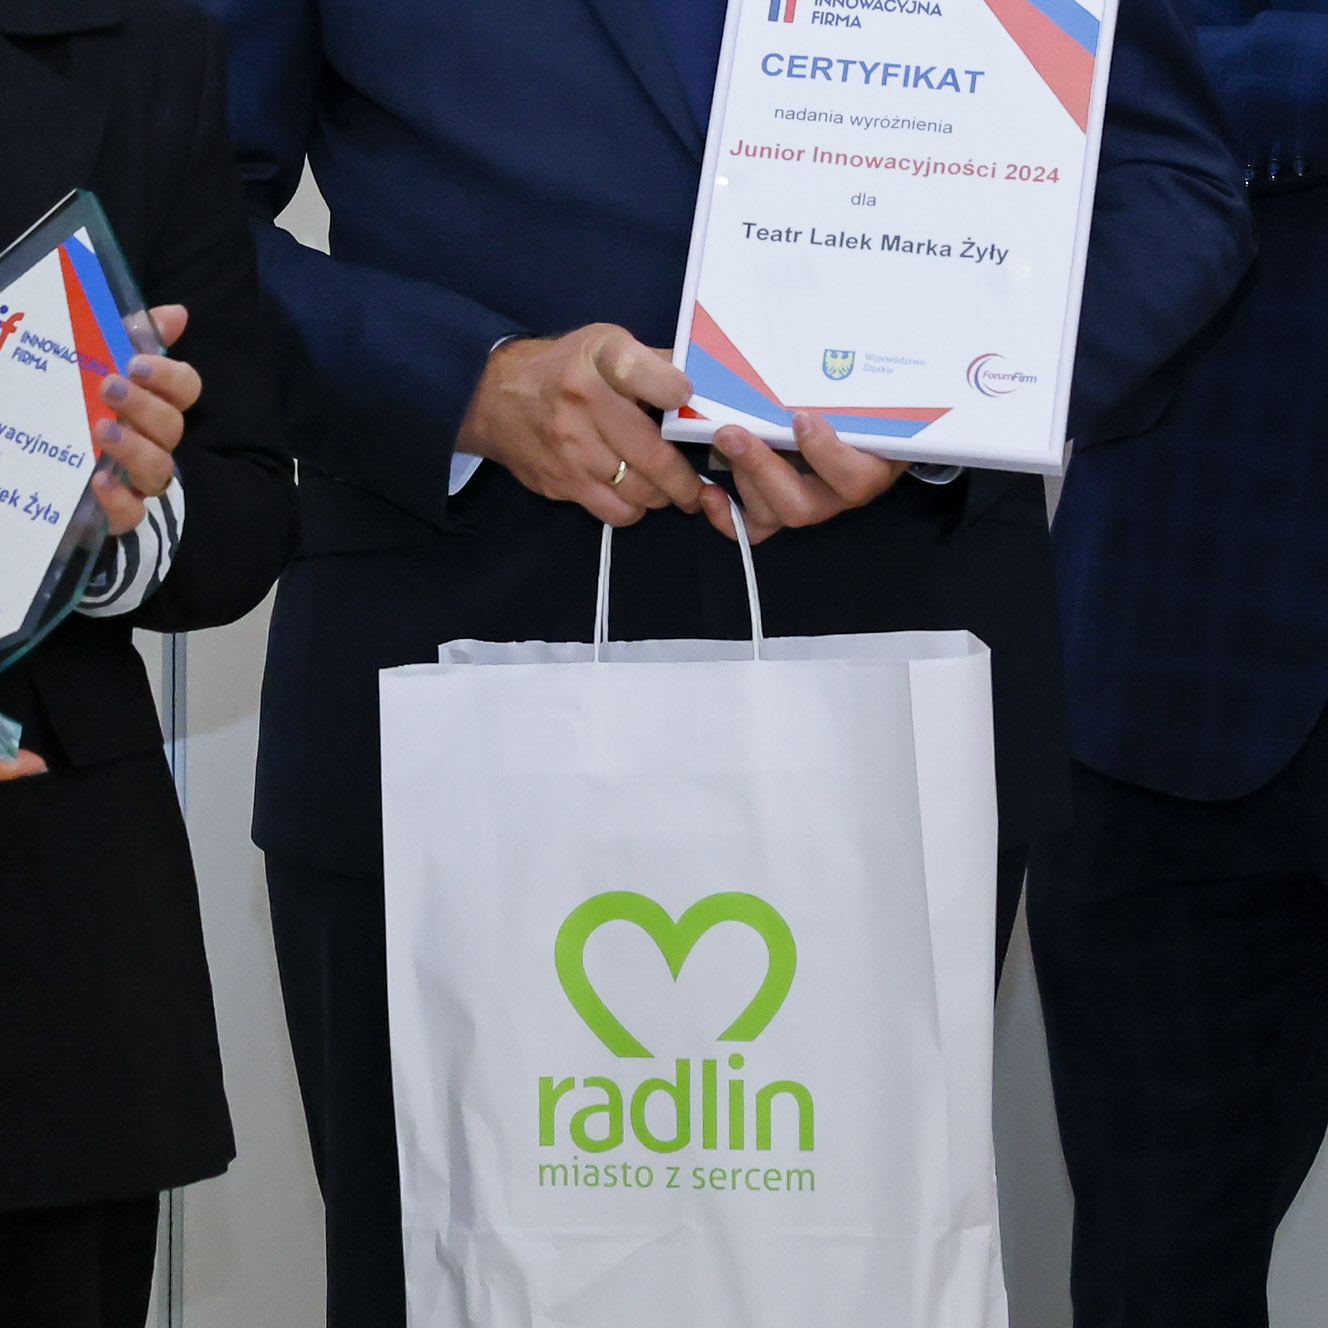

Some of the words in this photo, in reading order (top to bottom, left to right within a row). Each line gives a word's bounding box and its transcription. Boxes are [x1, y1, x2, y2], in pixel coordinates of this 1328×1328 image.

[811, 10, 862, 29] FIRMA
[761, 53, 985, 94] CERTYFIKAT
[774, 107, 844, 124] nadania
[850, 114, 953, 134] wyróżnienia
[729, 140, 805, 162] Junior
[812, 146, 997, 178] Innowacyjności
[1004, 163, 1060, 184] 2024
[851, 192, 877, 207] dla
[742, 222, 803, 243] Teatr
[810, 227, 872, 250] Lalek
[880, 234, 952, 257] Marka
[959, 237, 1009, 266] Żyły
[11, 346, 48, 372] FIRMA
[23, 492, 61, 525] Żyła
[539, 1052, 814, 1153] radlin
[539, 1155, 653, 1189] miasto
[666, 1166, 681, 1189] z
[692, 1164, 816, 1192] sercem
